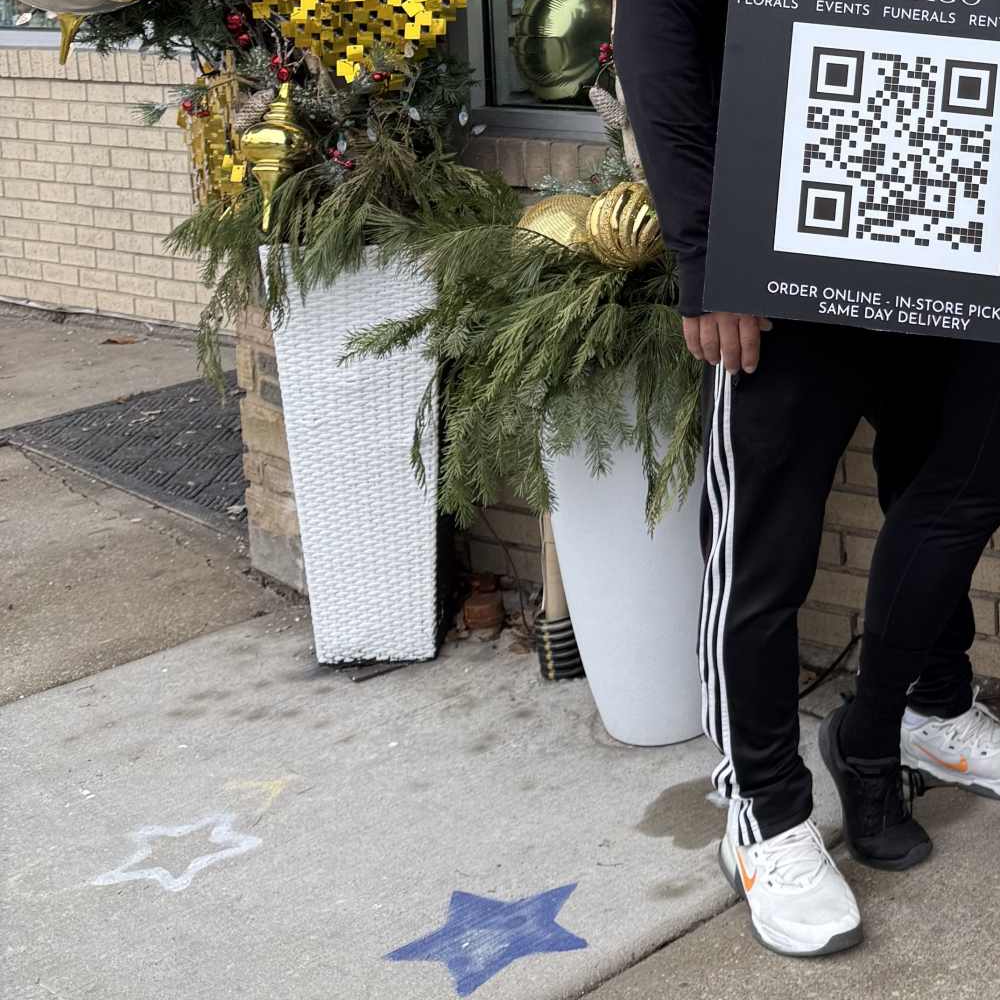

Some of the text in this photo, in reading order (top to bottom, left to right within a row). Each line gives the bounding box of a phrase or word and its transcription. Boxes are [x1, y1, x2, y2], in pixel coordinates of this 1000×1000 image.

[815, 0, 871, 16] EVENTS
[882, 5, 956, 24] FUNERALS
[767, 280, 818, 298] ORDER
[822, 287, 882, 306] ONLINE
[895, 295, 964, 316] IN-STORE
[818, 301, 971, 331] SAME DAY DELIVERY
